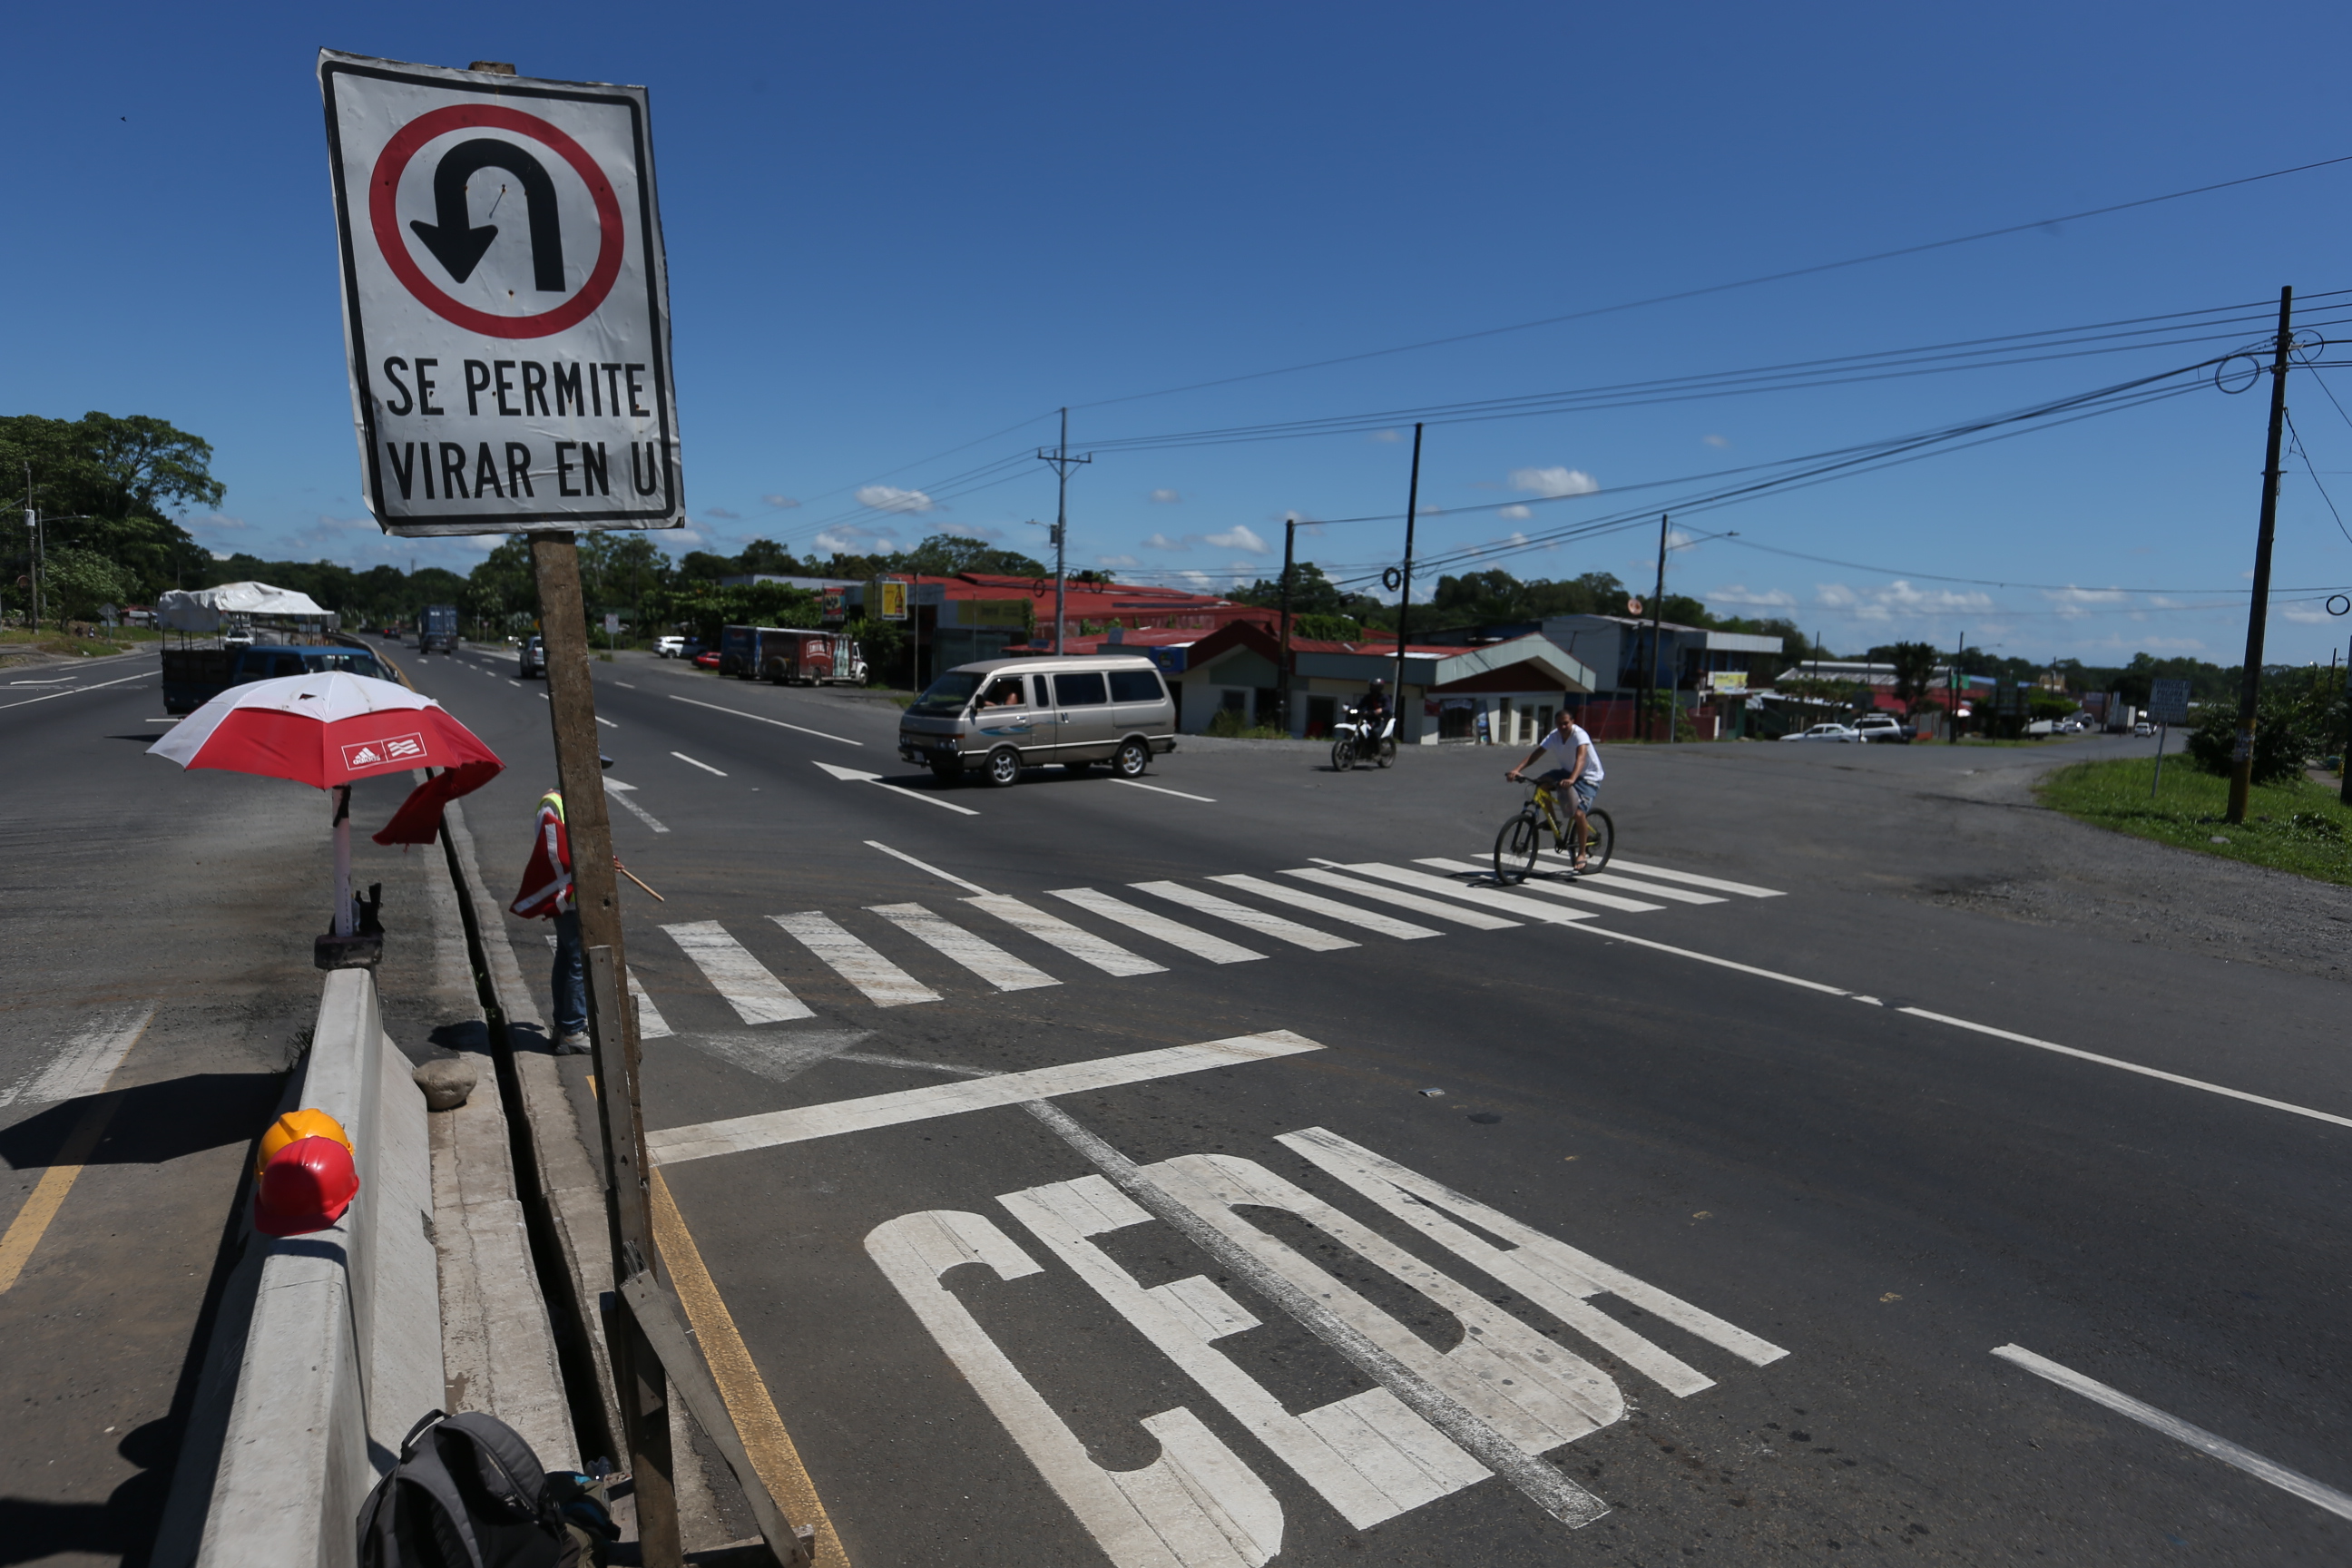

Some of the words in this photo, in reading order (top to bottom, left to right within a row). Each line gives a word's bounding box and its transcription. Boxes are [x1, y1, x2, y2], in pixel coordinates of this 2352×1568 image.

[383, 355, 445, 416] SE
[463, 358, 652, 418] PERMITE
[386, 441, 535, 501] VIRAR
[555, 441, 611, 497] EN
[631, 441, 658, 496] U
[352, 754, 381, 765] adidas
[863, 1126, 1791, 1568] CEDA
